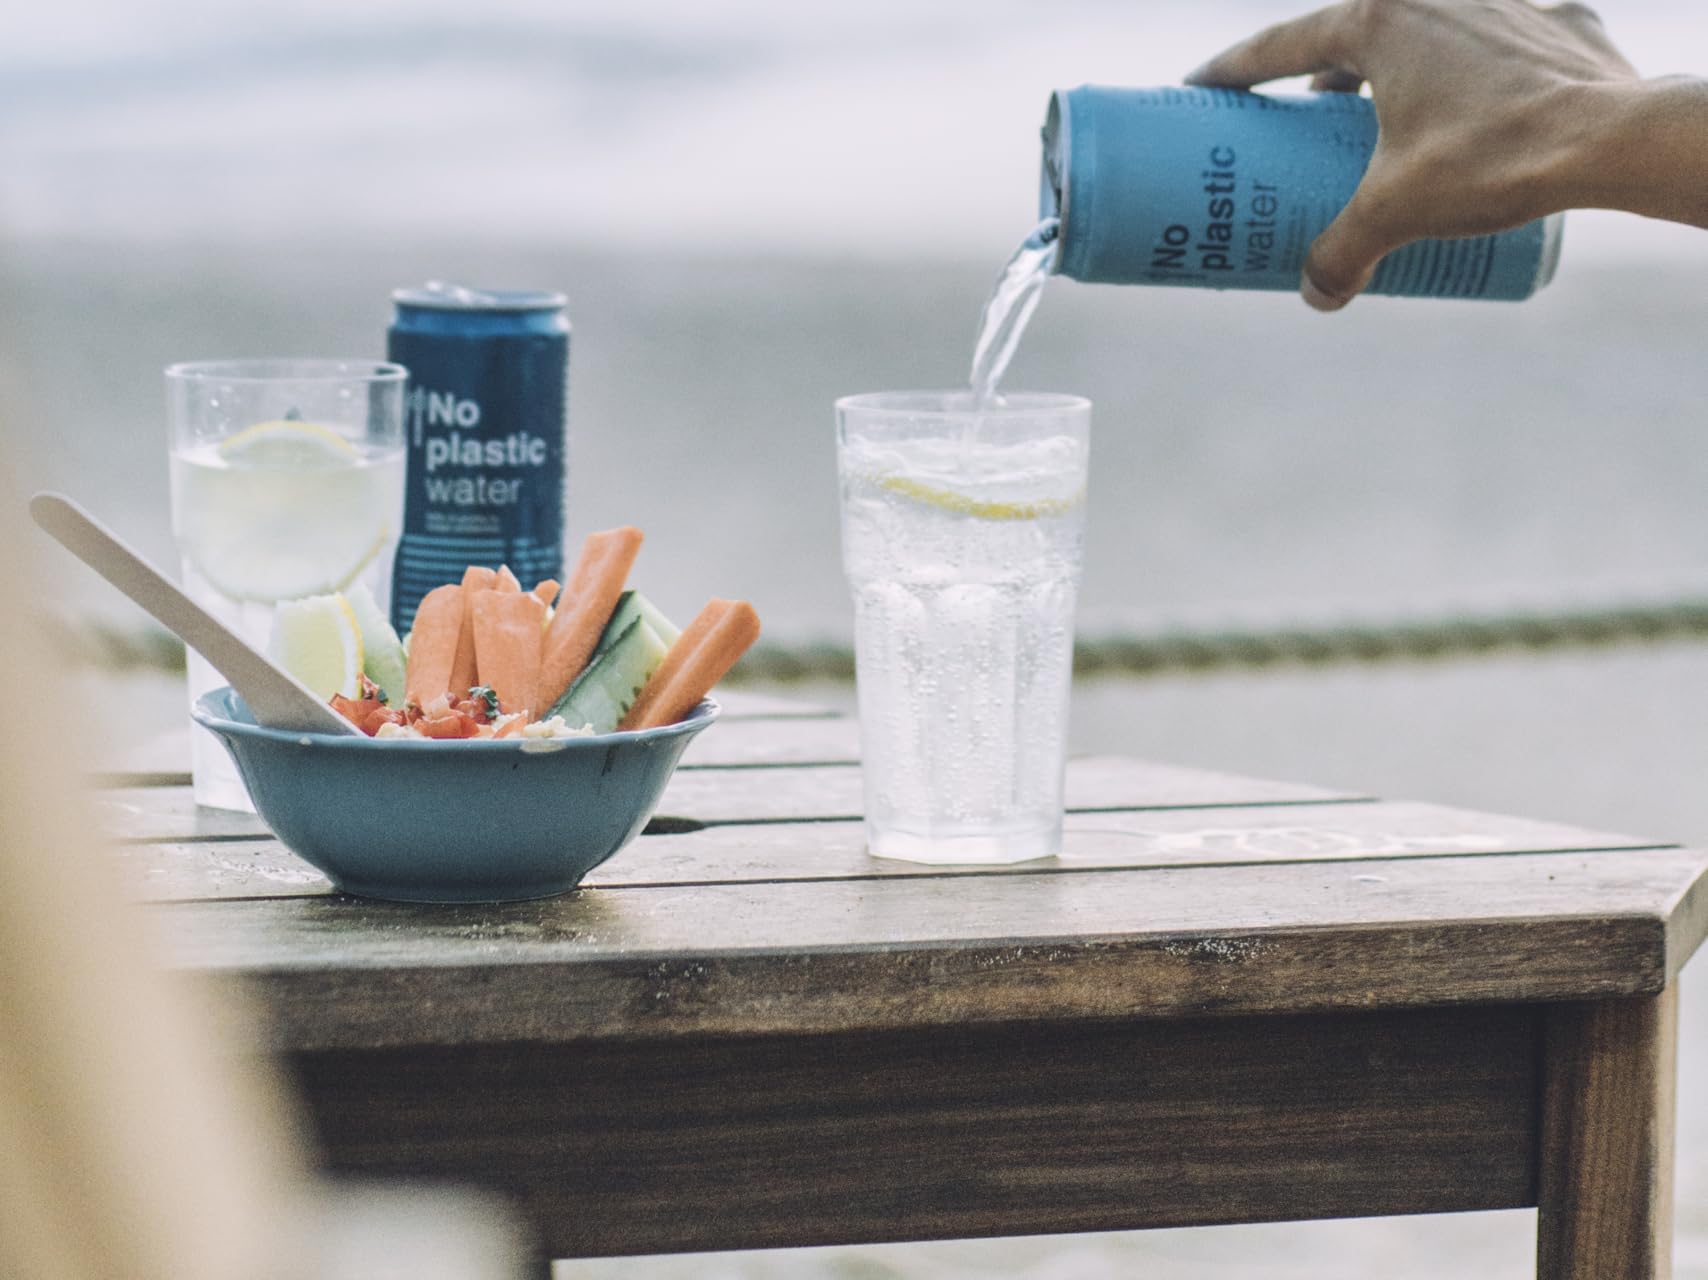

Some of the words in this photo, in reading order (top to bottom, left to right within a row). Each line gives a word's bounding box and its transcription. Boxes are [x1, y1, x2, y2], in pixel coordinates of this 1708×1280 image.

[1197, 145, 1237, 271] plastic
[1243, 179, 1278, 273] water
[1152, 224, 1190, 269] No
[427, 392, 481, 427] No
[426, 433, 548, 470] plastic
[425, 476, 523, 504] water
